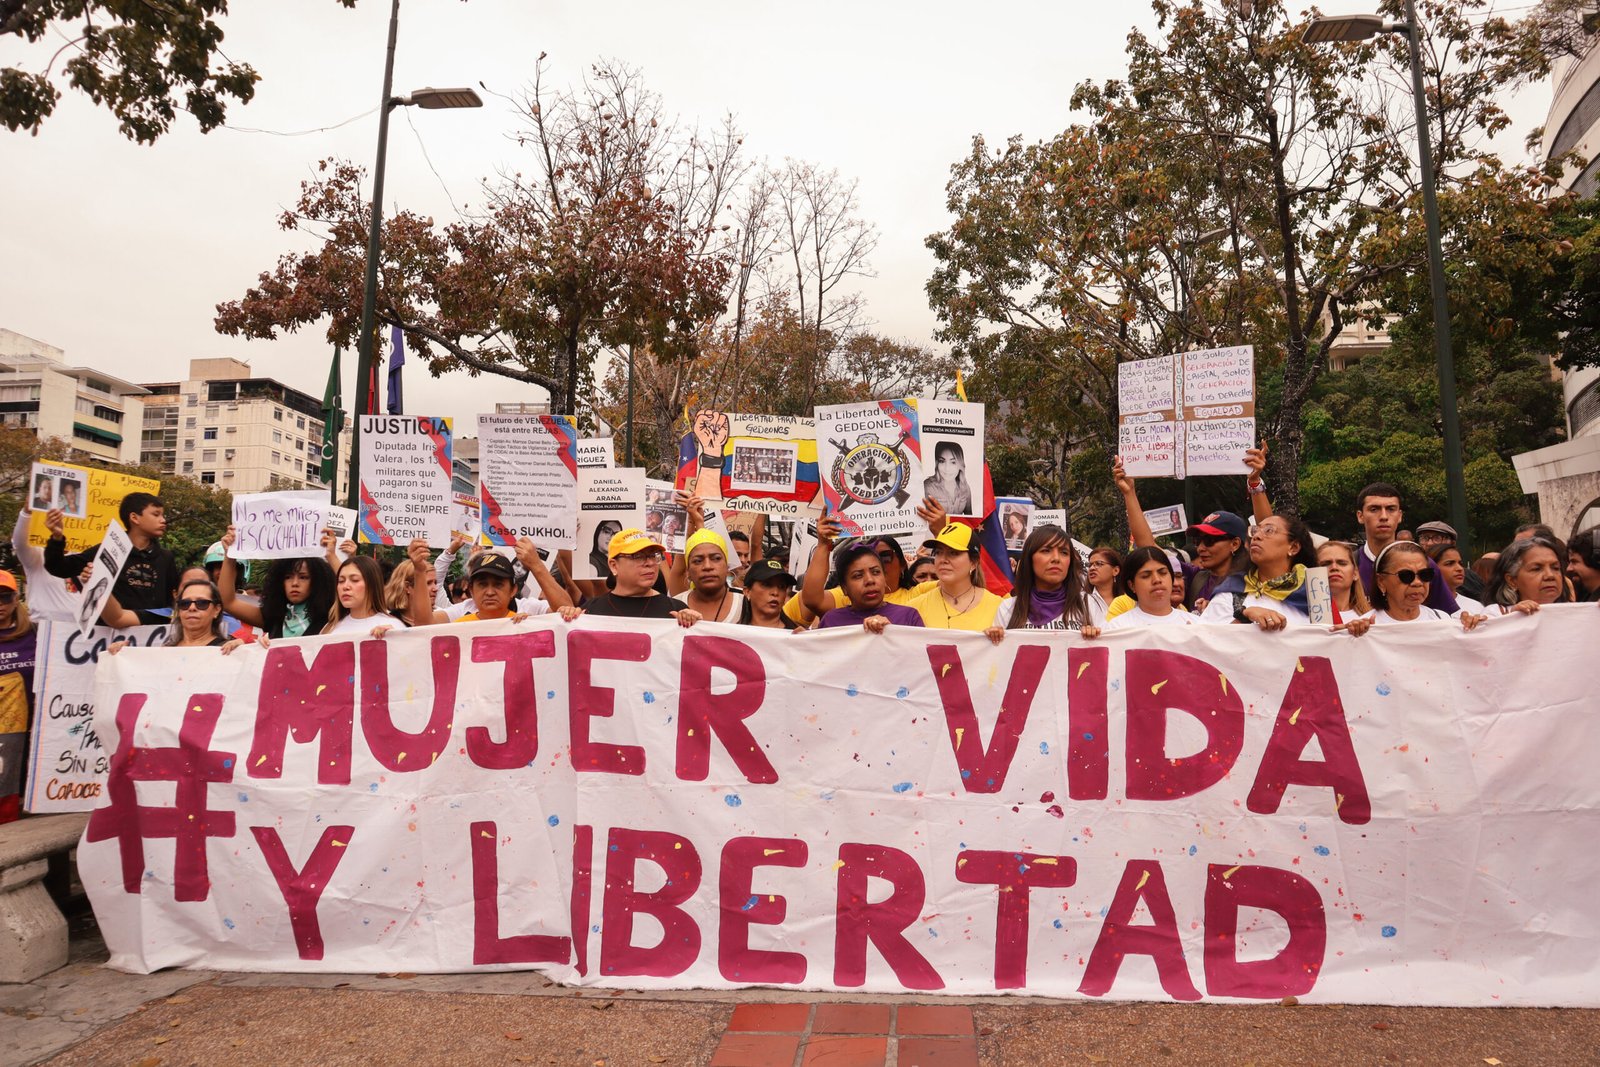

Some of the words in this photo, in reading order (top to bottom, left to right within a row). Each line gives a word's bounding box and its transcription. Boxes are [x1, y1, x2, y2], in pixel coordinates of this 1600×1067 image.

[1186, 353, 1197, 361] NO
[1202, 350, 1233, 359] SOMOS
[1135, 361, 1144, 369] NO
[1239, 358, 1250, 366] DE
[1147, 384, 1157, 393] LA
[1186, 382, 1195, 390] LA
[1201, 393, 1215, 401] LOS
[1147, 397, 1173, 409] GRITAR
[819, 412, 832, 421] La
[835, 407, 880, 420] Libertad
[883, 406, 897, 415] de
[899, 405, 916, 414] los
[936, 407, 962, 415] YANIN
[1196, 406, 1242, 417] IGUALDAD
[525, 417, 572, 425] VENEZUELA
[934, 417, 964, 426] PERNIA
[364, 418, 450, 435] JUSTICIA
[1120, 427, 1130, 435] NO
[1134, 426, 1146, 434] ES
[1150, 425, 1171, 434] MODA
[1136, 434, 1161, 443] LUCHA
[1188, 433, 1198, 441] LA
[375, 441, 417, 452] Diputada
[422, 443, 437, 451] Iris
[1148, 442, 1174, 451] LIBRES
[1188, 443, 1205, 451] POR
[410, 455, 425, 464] los
[428, 456, 439, 465] 13
[847, 448, 893, 468] OPERACION
[1126, 455, 1139, 463] SIN
[42, 468, 76, 479] LIBERTAD
[376, 468, 415, 477] militares
[418, 470, 436, 479] que
[379, 479, 418, 488] pagaron
[420, 480, 432, 488] su
[368, 491, 409, 499] condena
[411, 492, 443, 502] siguen
[851, 484, 892, 499] GEDEON
[235, 501, 257, 522] No
[263, 508, 282, 523] me
[287, 506, 320, 523] mires
[405, 504, 449, 514] SIEMPRE
[844, 508, 895, 521] convertirá
[898, 508, 911, 516] en
[384, 516, 426, 526] FUERON
[488, 525, 517, 535] Caso
[520, 526, 572, 539] SUKHOI..
[861, 523, 877, 532] del
[378, 527, 431, 539] INOCENTE.
[925, 644, 1372, 826] VIDA
[250, 824, 355, 960] Y
[470, 820, 1327, 1001] LIBERTAD
